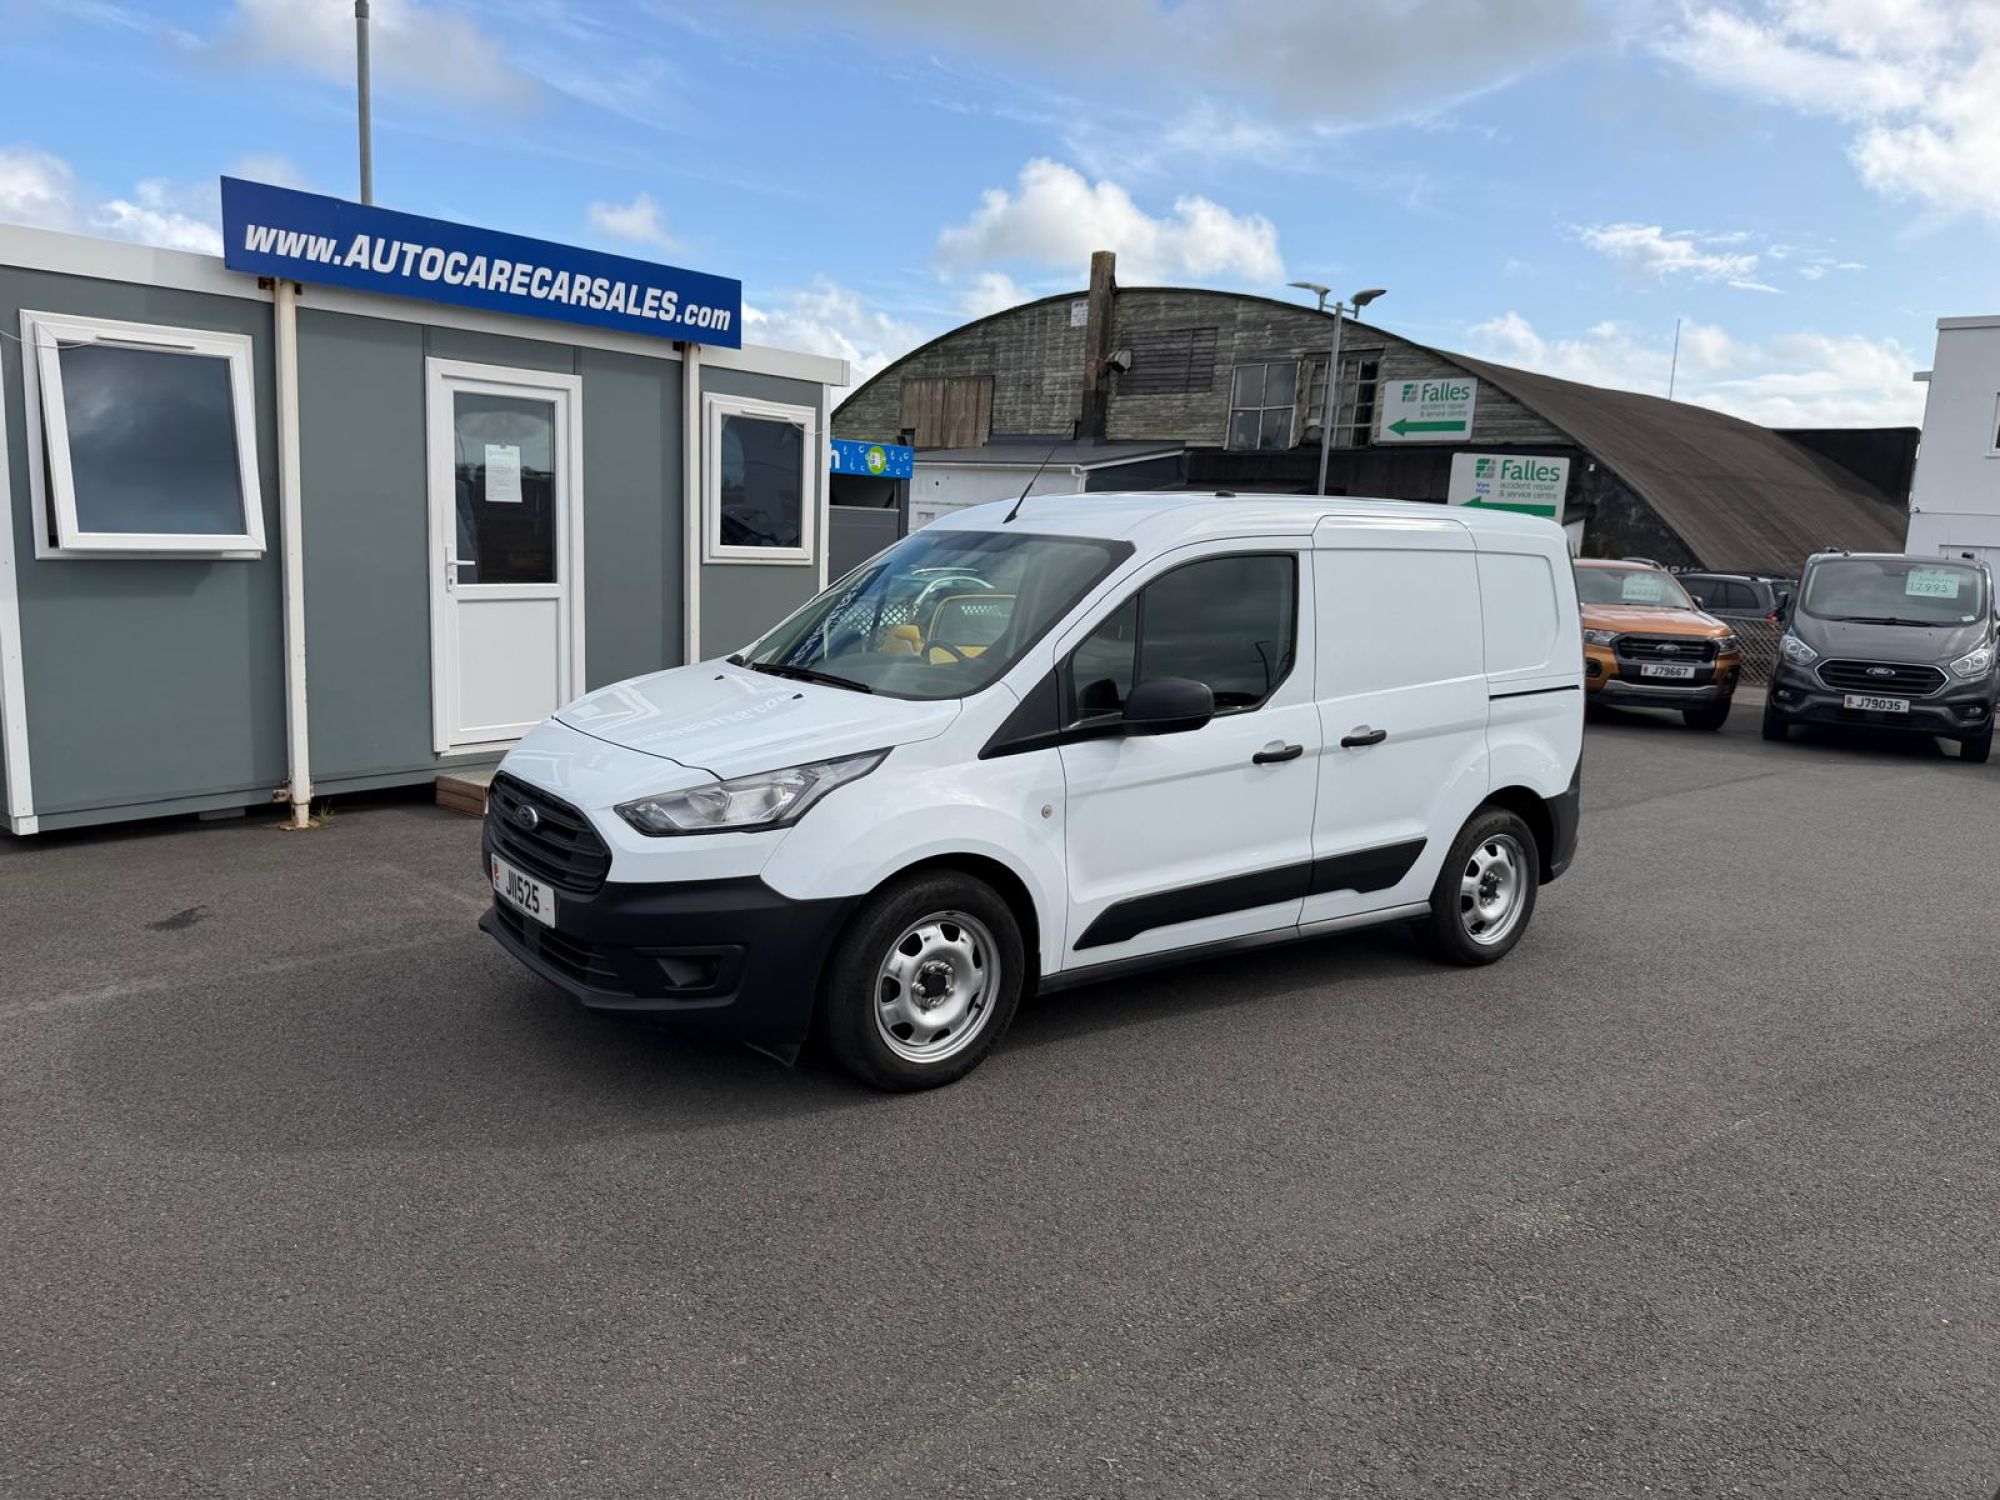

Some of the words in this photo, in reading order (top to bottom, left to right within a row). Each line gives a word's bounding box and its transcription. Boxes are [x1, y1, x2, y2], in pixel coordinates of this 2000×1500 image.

[245, 224, 732, 332] www.AUTOCARECARSALES.com
[1421, 382, 1470, 401] Falles
[1500, 459, 1561, 481] Falles
[1499, 482, 1530, 490] accident
[1532, 483, 1555, 491] repair
[1856, 697, 1901, 711] J79035
